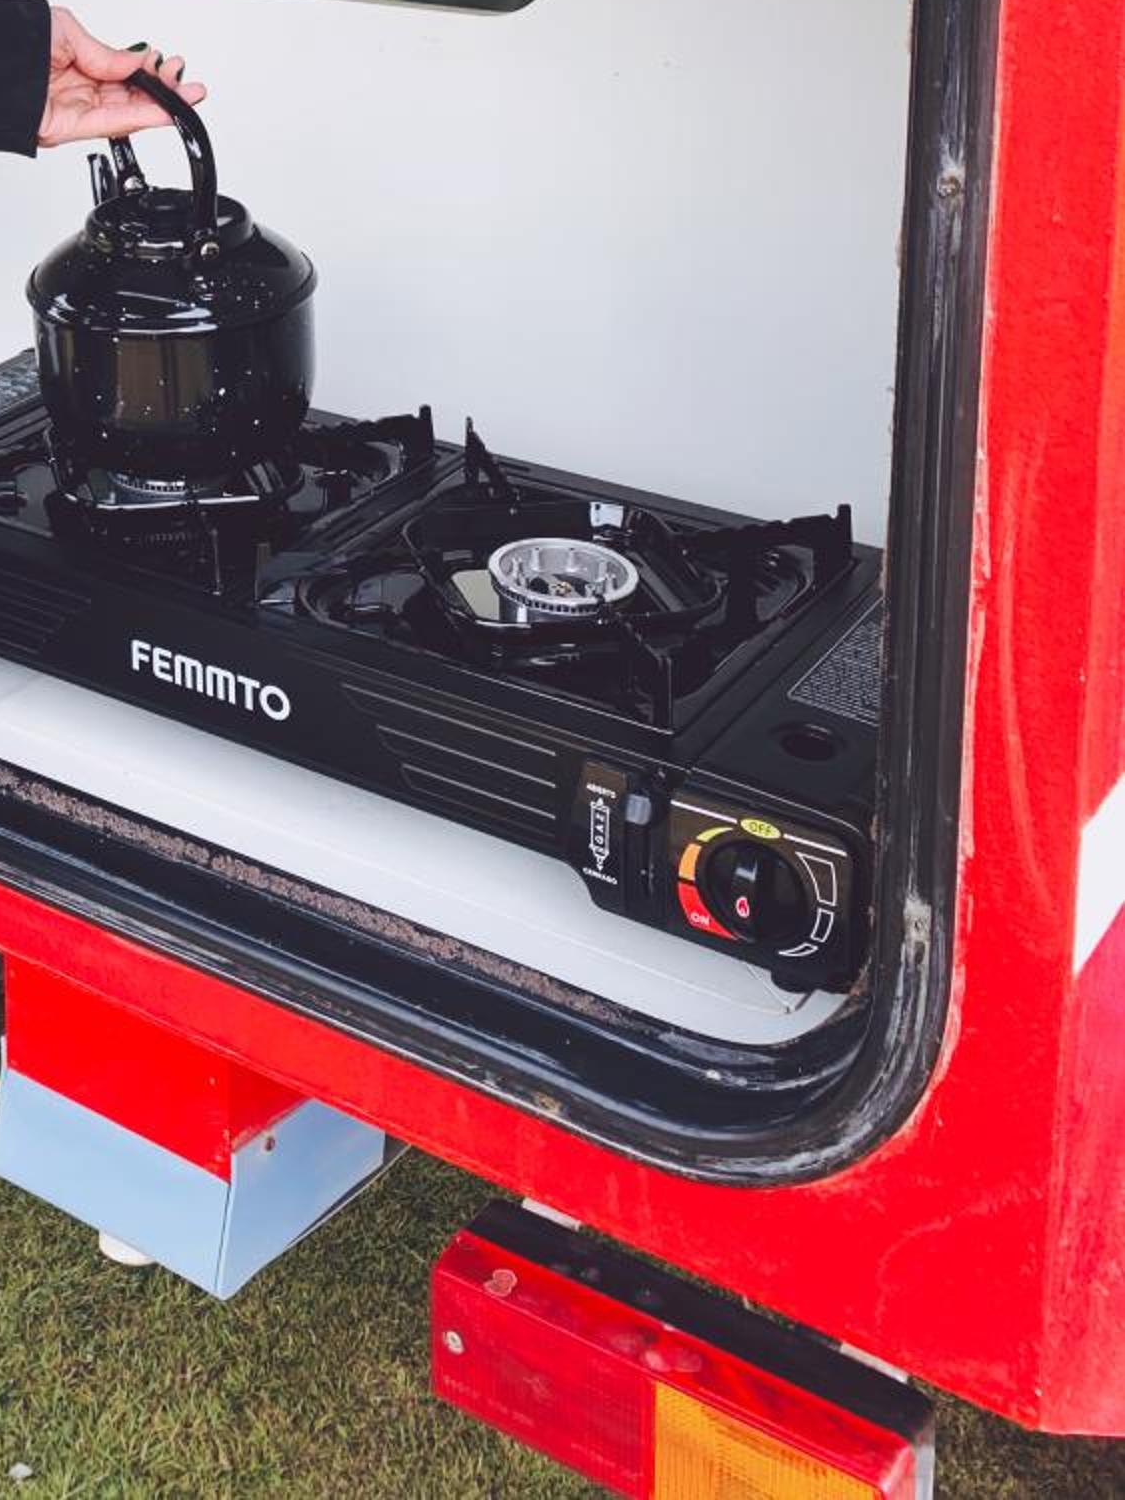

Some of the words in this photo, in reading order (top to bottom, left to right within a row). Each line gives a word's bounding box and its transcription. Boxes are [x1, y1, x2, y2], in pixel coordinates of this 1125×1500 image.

[131, 639, 291, 721] FEMMTO
[748, 820, 774, 837] OFF
[690, 912, 711, 926] ON
